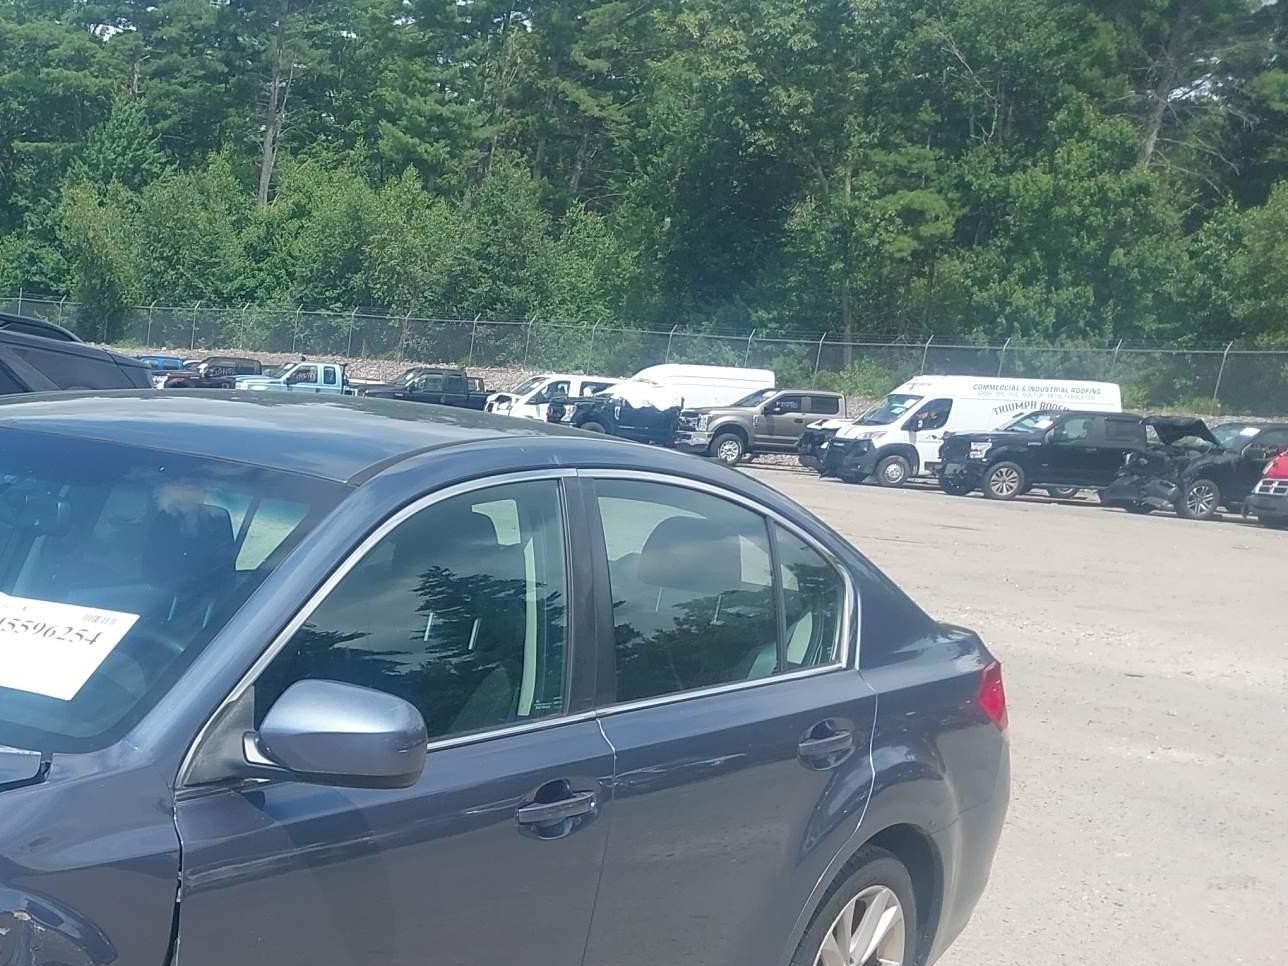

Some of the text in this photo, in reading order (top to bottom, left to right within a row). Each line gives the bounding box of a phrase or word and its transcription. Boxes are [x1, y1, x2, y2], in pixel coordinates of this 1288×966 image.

[972, 383, 1019, 392] COMMERCIAL
[1027, 385, 1069, 393] INDUSTRIAL
[1070, 387, 1102, 395] ROOFING
[992, 401, 1038, 416] TRIUMPH
